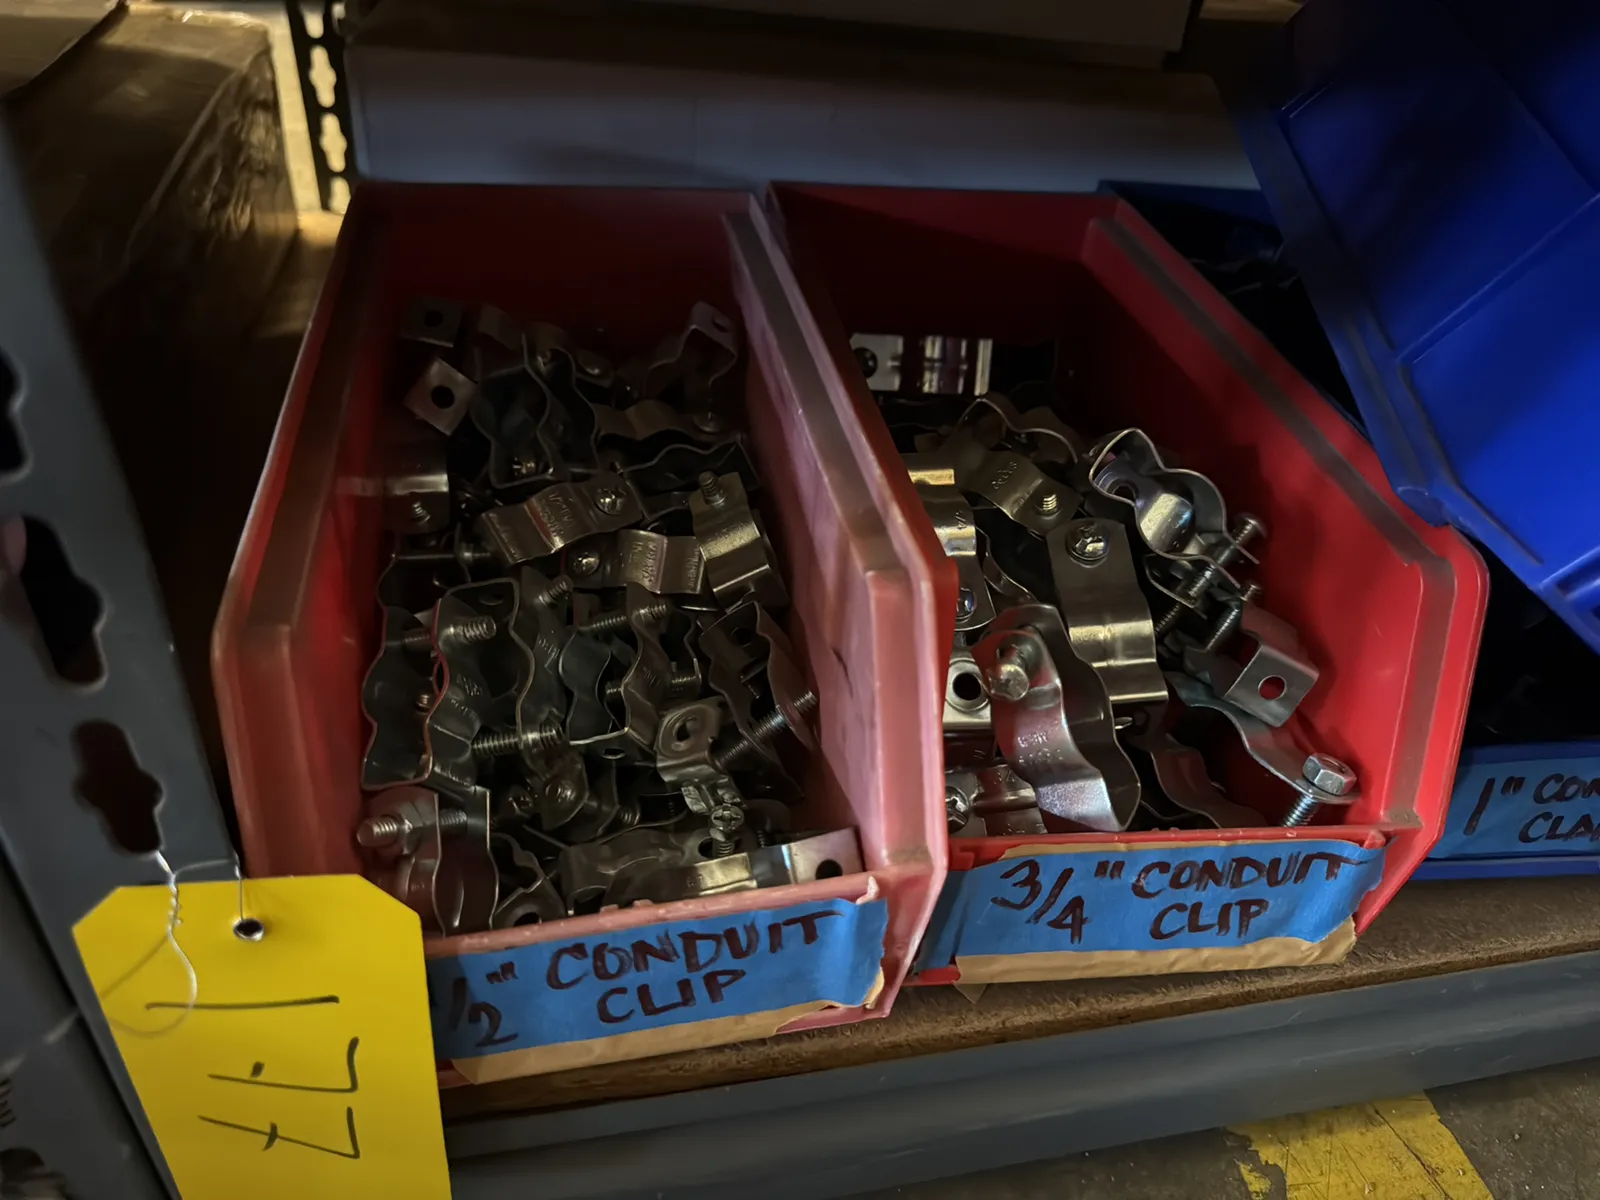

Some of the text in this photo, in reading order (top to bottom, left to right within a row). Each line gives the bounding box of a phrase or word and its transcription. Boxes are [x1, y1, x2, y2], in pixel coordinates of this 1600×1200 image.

[1131, 852, 1368, 899] CONDUIT
[1150, 898, 1270, 940] CLIP
[546, 909, 844, 990] CONDUIT
[597, 969, 747, 1024] CLIP
